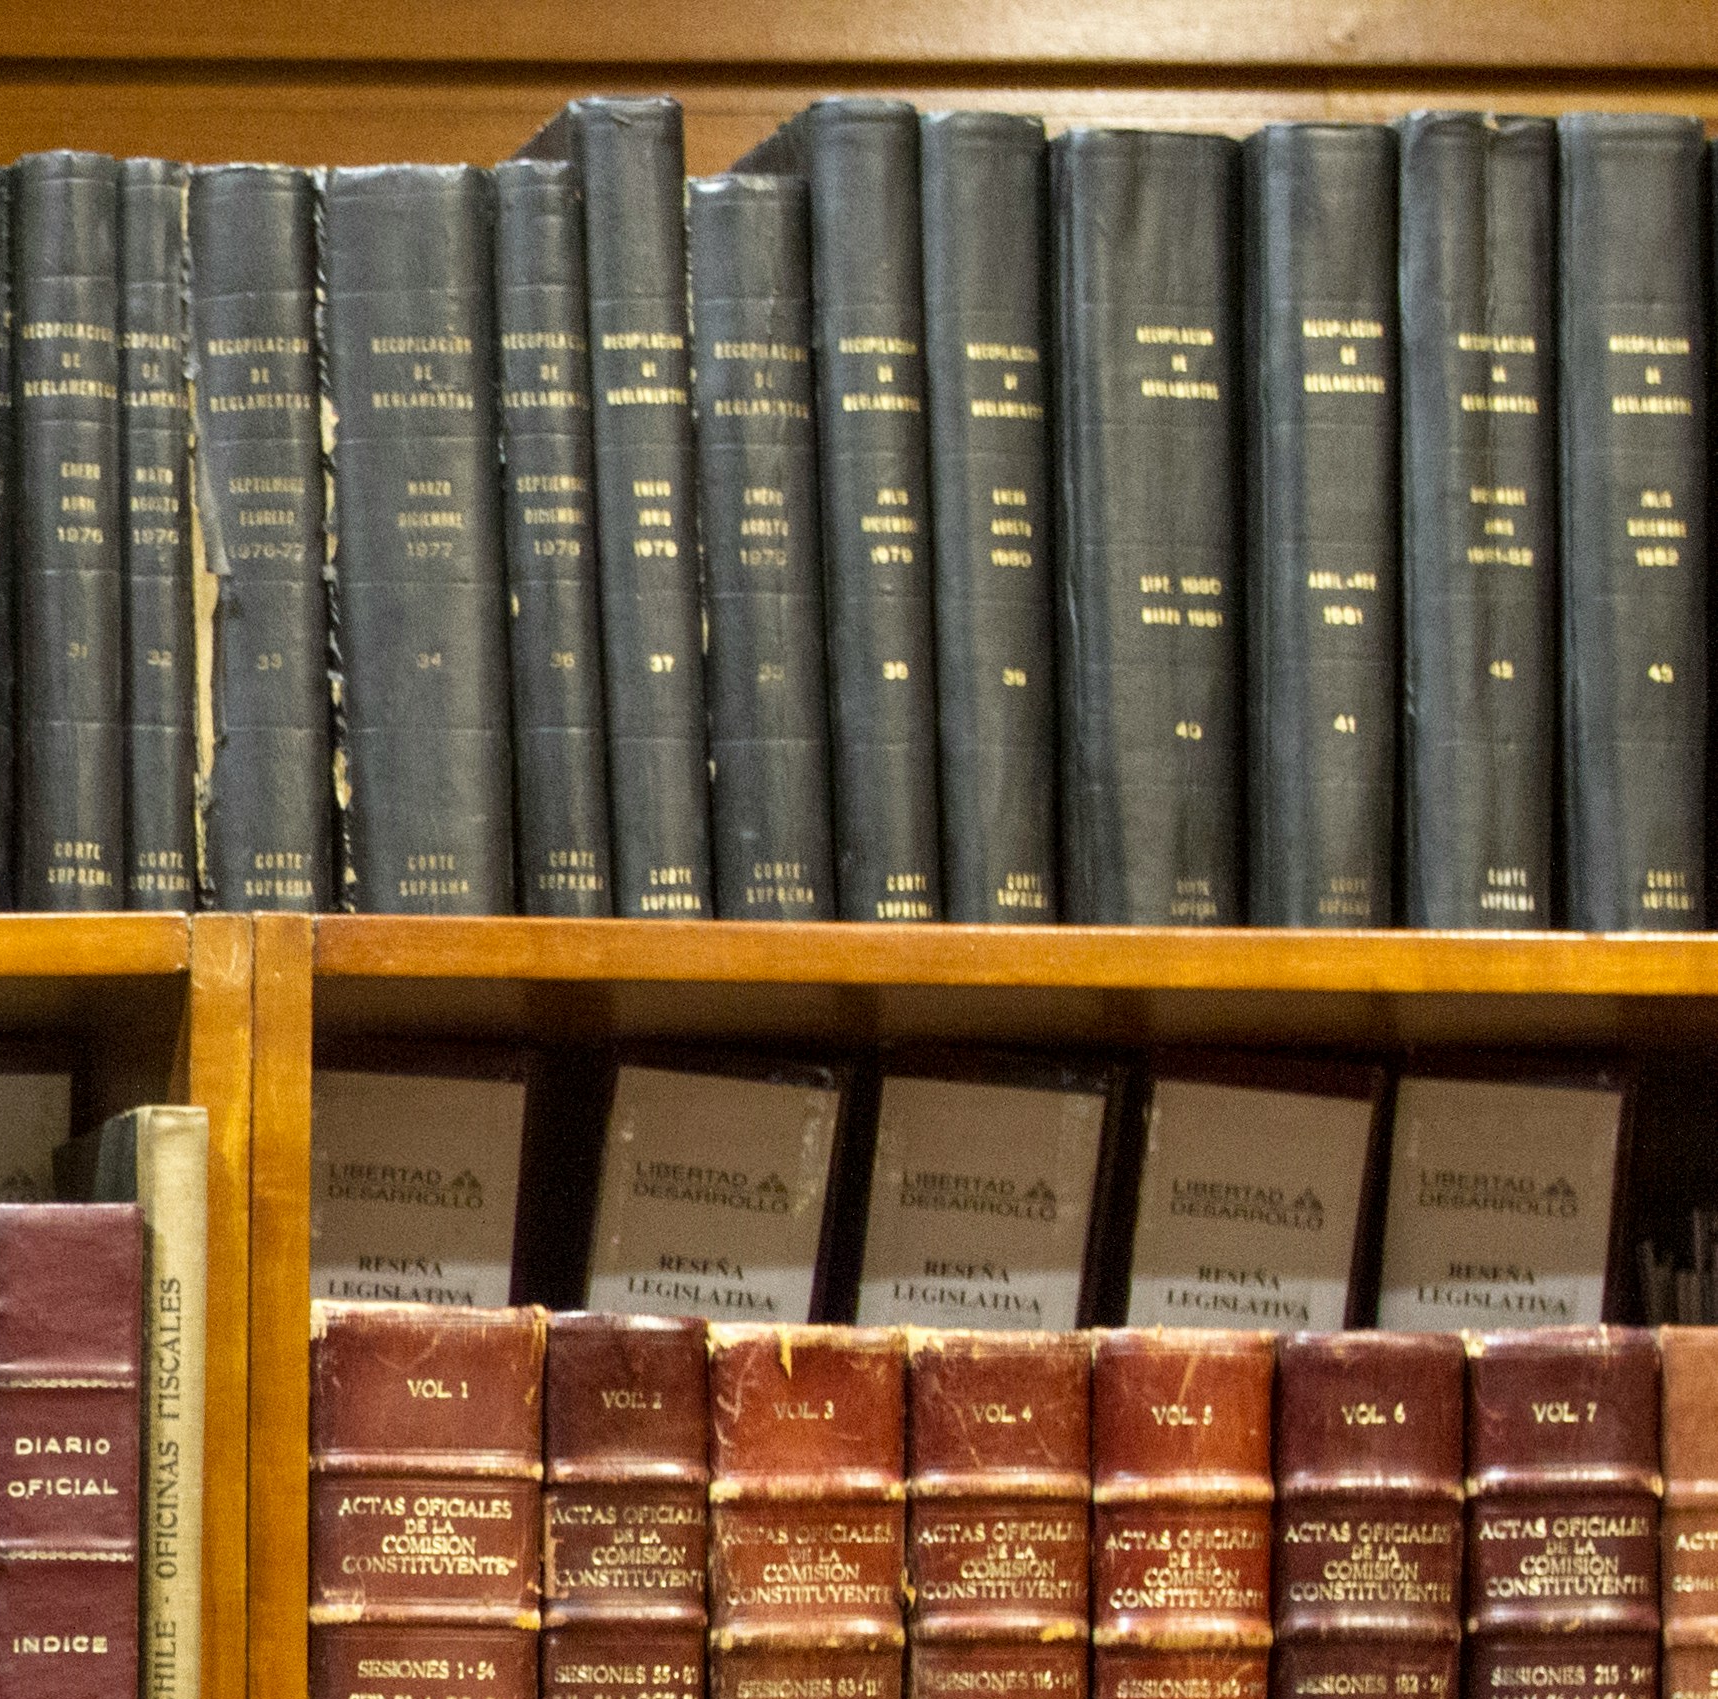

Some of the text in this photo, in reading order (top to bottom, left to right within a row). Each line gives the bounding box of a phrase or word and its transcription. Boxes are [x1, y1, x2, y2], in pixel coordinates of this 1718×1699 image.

[159, 1276, 182, 1423] FISCALES
[460, 1381, 469, 1399] 1
[973, 1405, 1033, 1425] VOL. 4
[1532, 1402, 1598, 1425] VOL. 7
[15, 1437, 111, 1455] DIARIO
[7, 1478, 118, 1498] OFICIAL
[155, 1439, 180, 1580] OFICINAS
[338, 1497, 512, 1520] ACTAS OFICIALES
[405, 1519, 454, 1534] DE LA
[13, 1636, 108, 1654] INDICE
